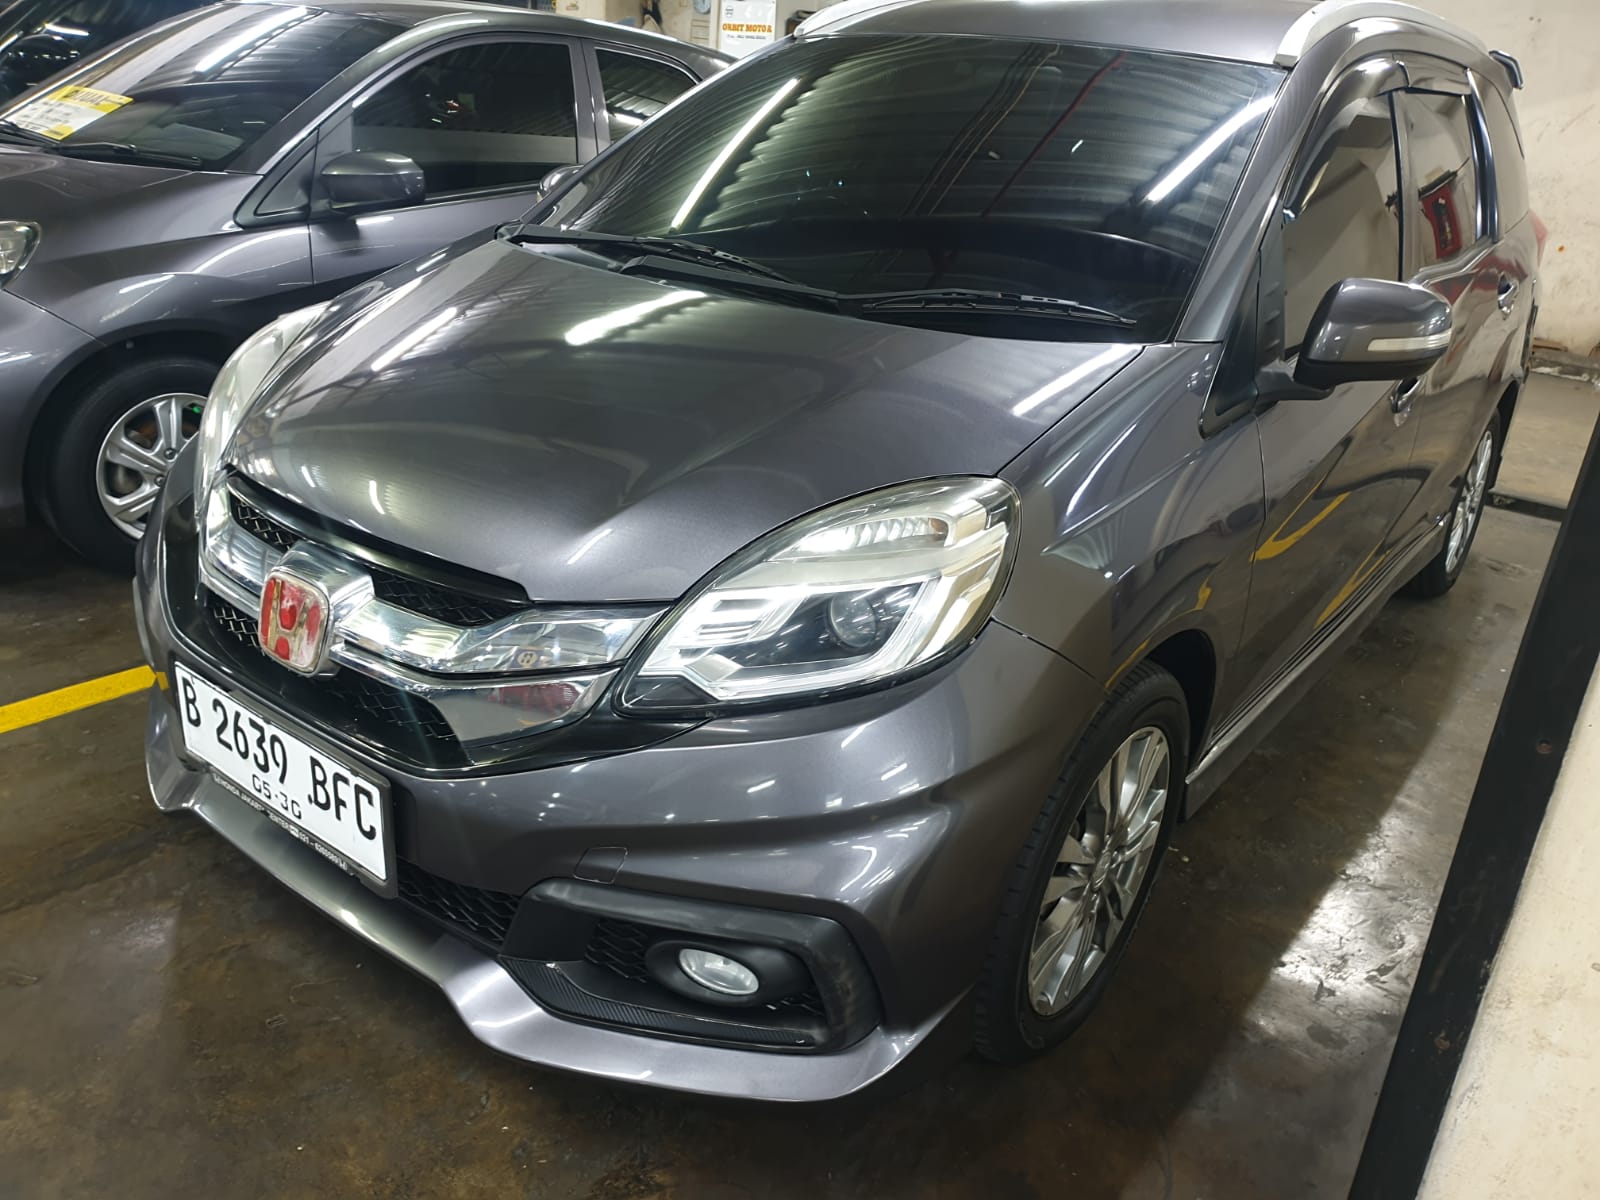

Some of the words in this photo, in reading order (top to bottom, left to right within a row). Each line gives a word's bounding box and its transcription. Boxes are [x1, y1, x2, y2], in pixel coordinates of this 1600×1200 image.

[722, 23, 745, 32] ORBIT
[182, 675, 201, 728] B
[212, 698, 288, 785] 2639
[309, 755, 377, 841] BFC
